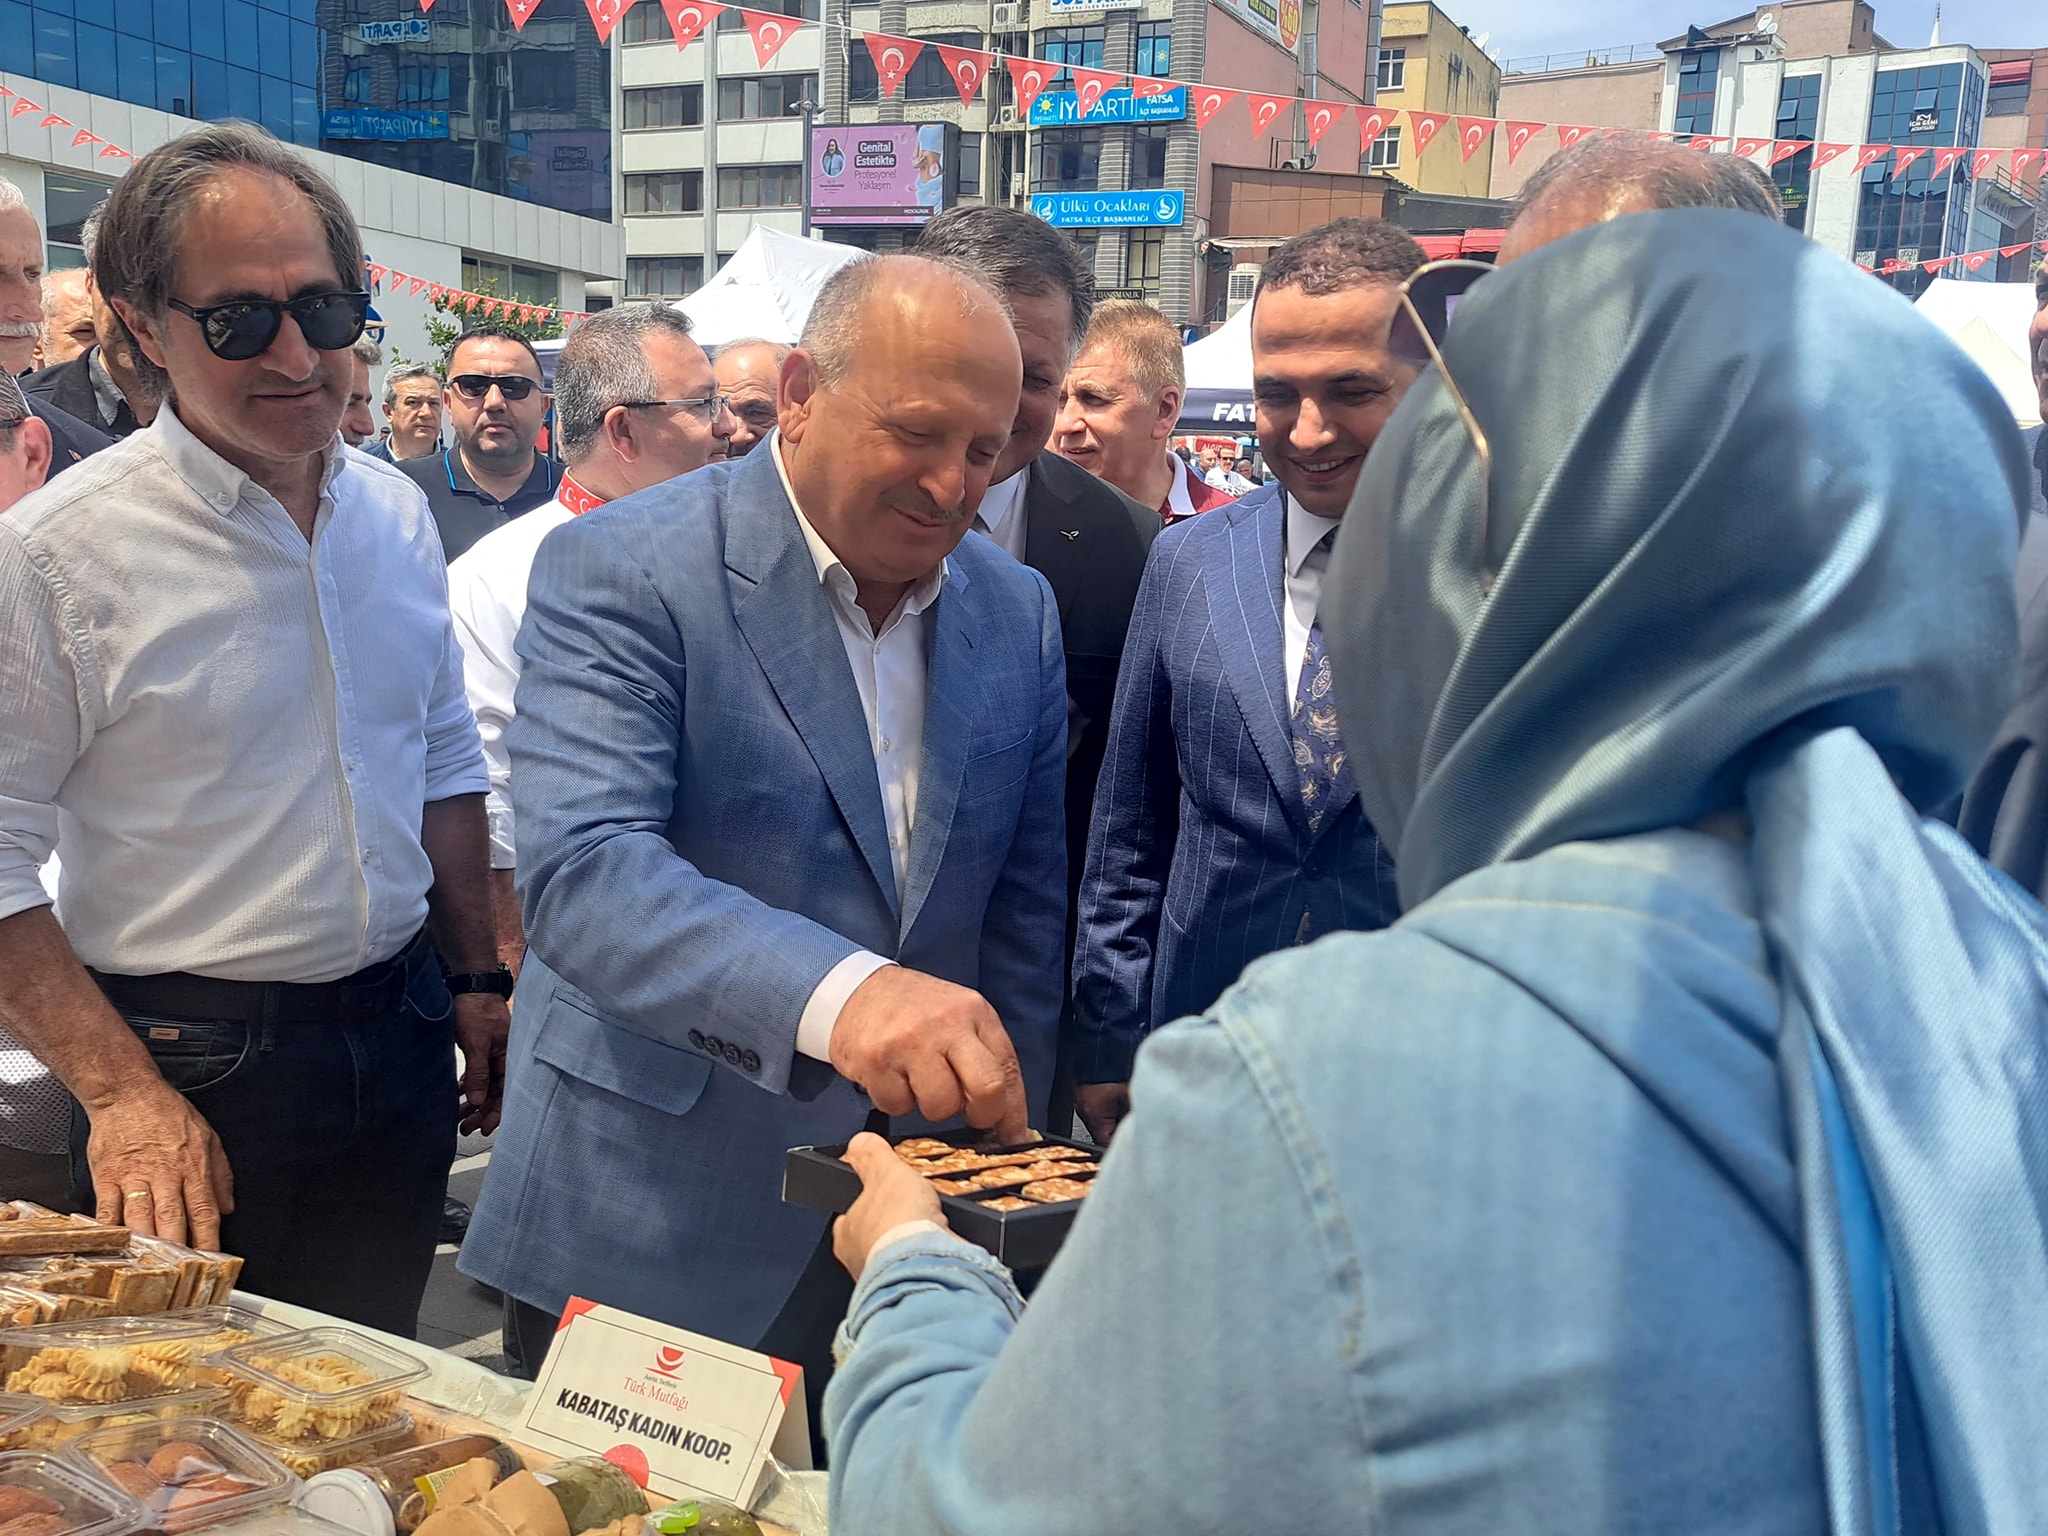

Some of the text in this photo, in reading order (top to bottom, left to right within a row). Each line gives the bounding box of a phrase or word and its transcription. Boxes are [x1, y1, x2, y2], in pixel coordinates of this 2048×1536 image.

[1147, 94, 1174, 104] FATSA
[860, 142, 891, 153] Genital
[856, 155, 895, 166] Estetikte
[855, 169, 896, 181] Profesyonel
[858, 181, 891, 191] Yaklaşım
[1085, 215, 1101, 224] İLÇE
[1103, 214, 1149, 224] BAŞKANLIĞI
[623, 1376, 689, 1412] Türk Mutfağı
[556, 1387, 733, 1465] KABATAŞ KADIN KOOP.
